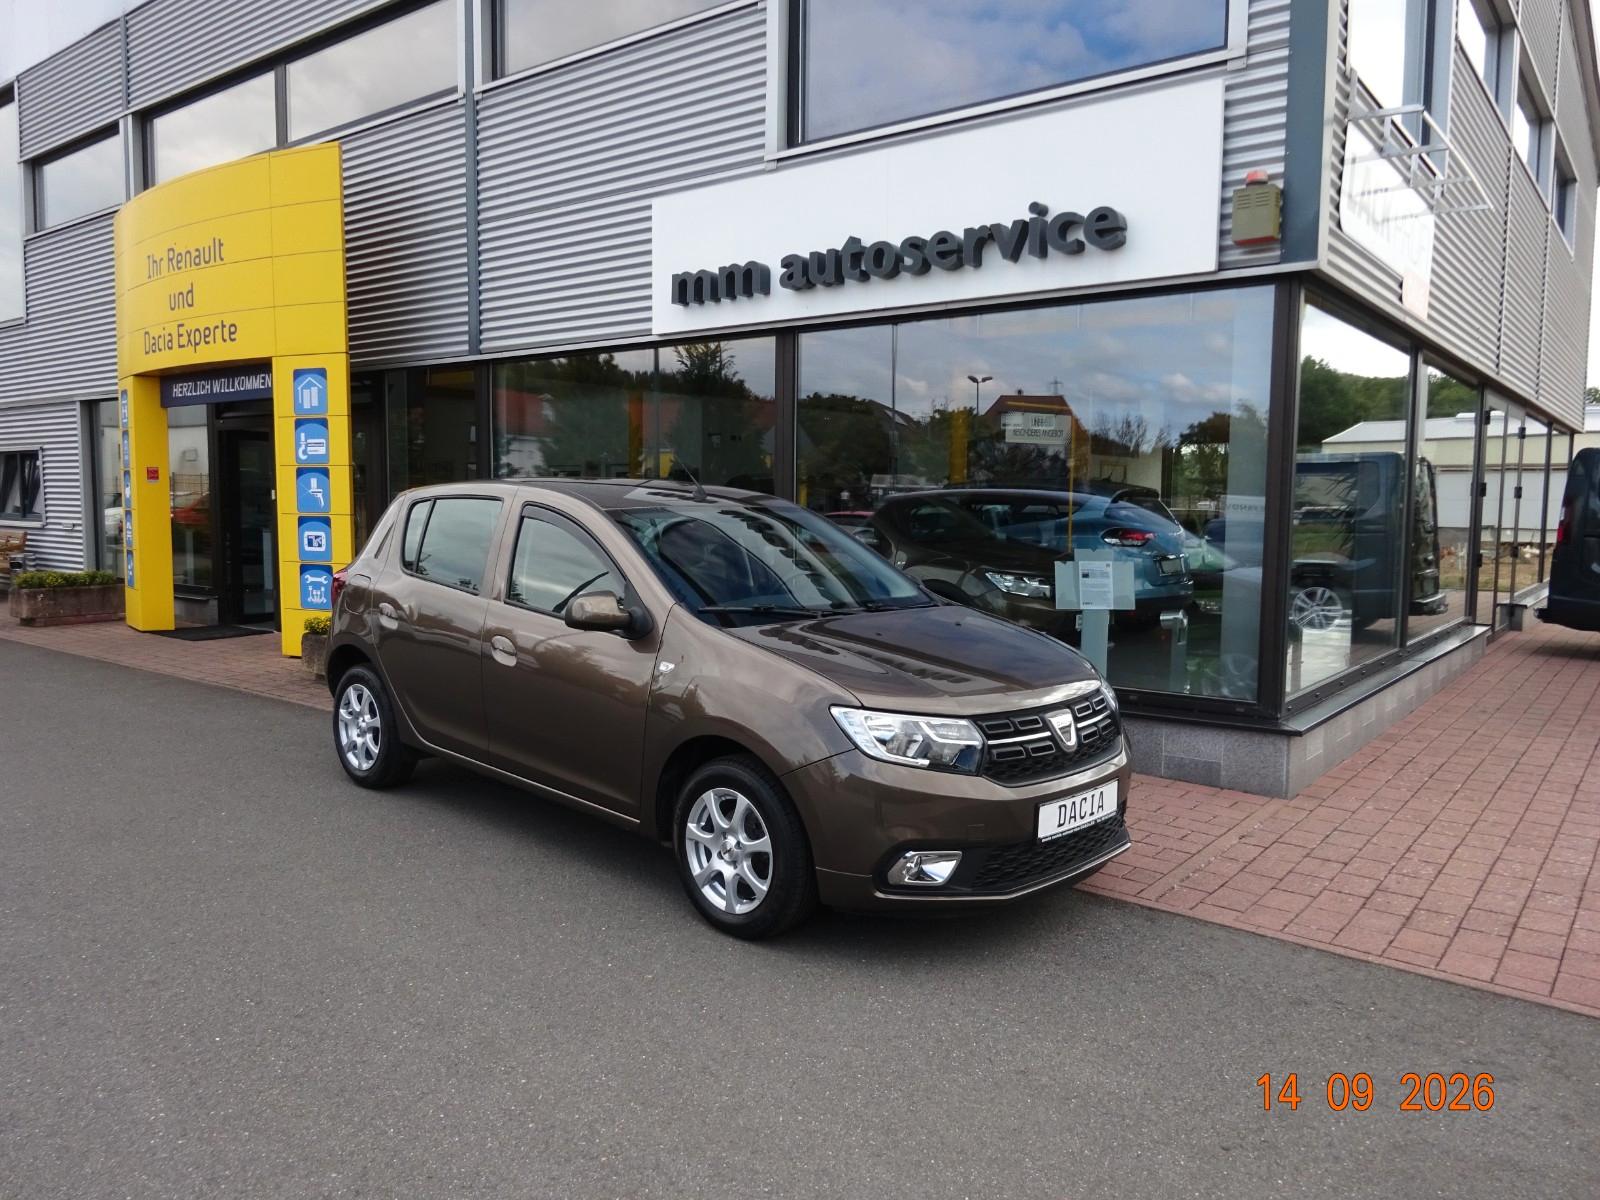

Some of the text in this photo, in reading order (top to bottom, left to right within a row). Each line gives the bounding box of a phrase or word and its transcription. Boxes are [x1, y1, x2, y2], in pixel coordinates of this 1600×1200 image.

[146, 237, 225, 280] Ihr Renault
[671, 201, 1128, 307] mm autoservice
[169, 281, 194, 311] und
[144, 319, 238, 355] Dacia Experte
[172, 373, 272, 398] HERZLICH WILLKOMMEN
[1057, 790, 1104, 828] DACIA
